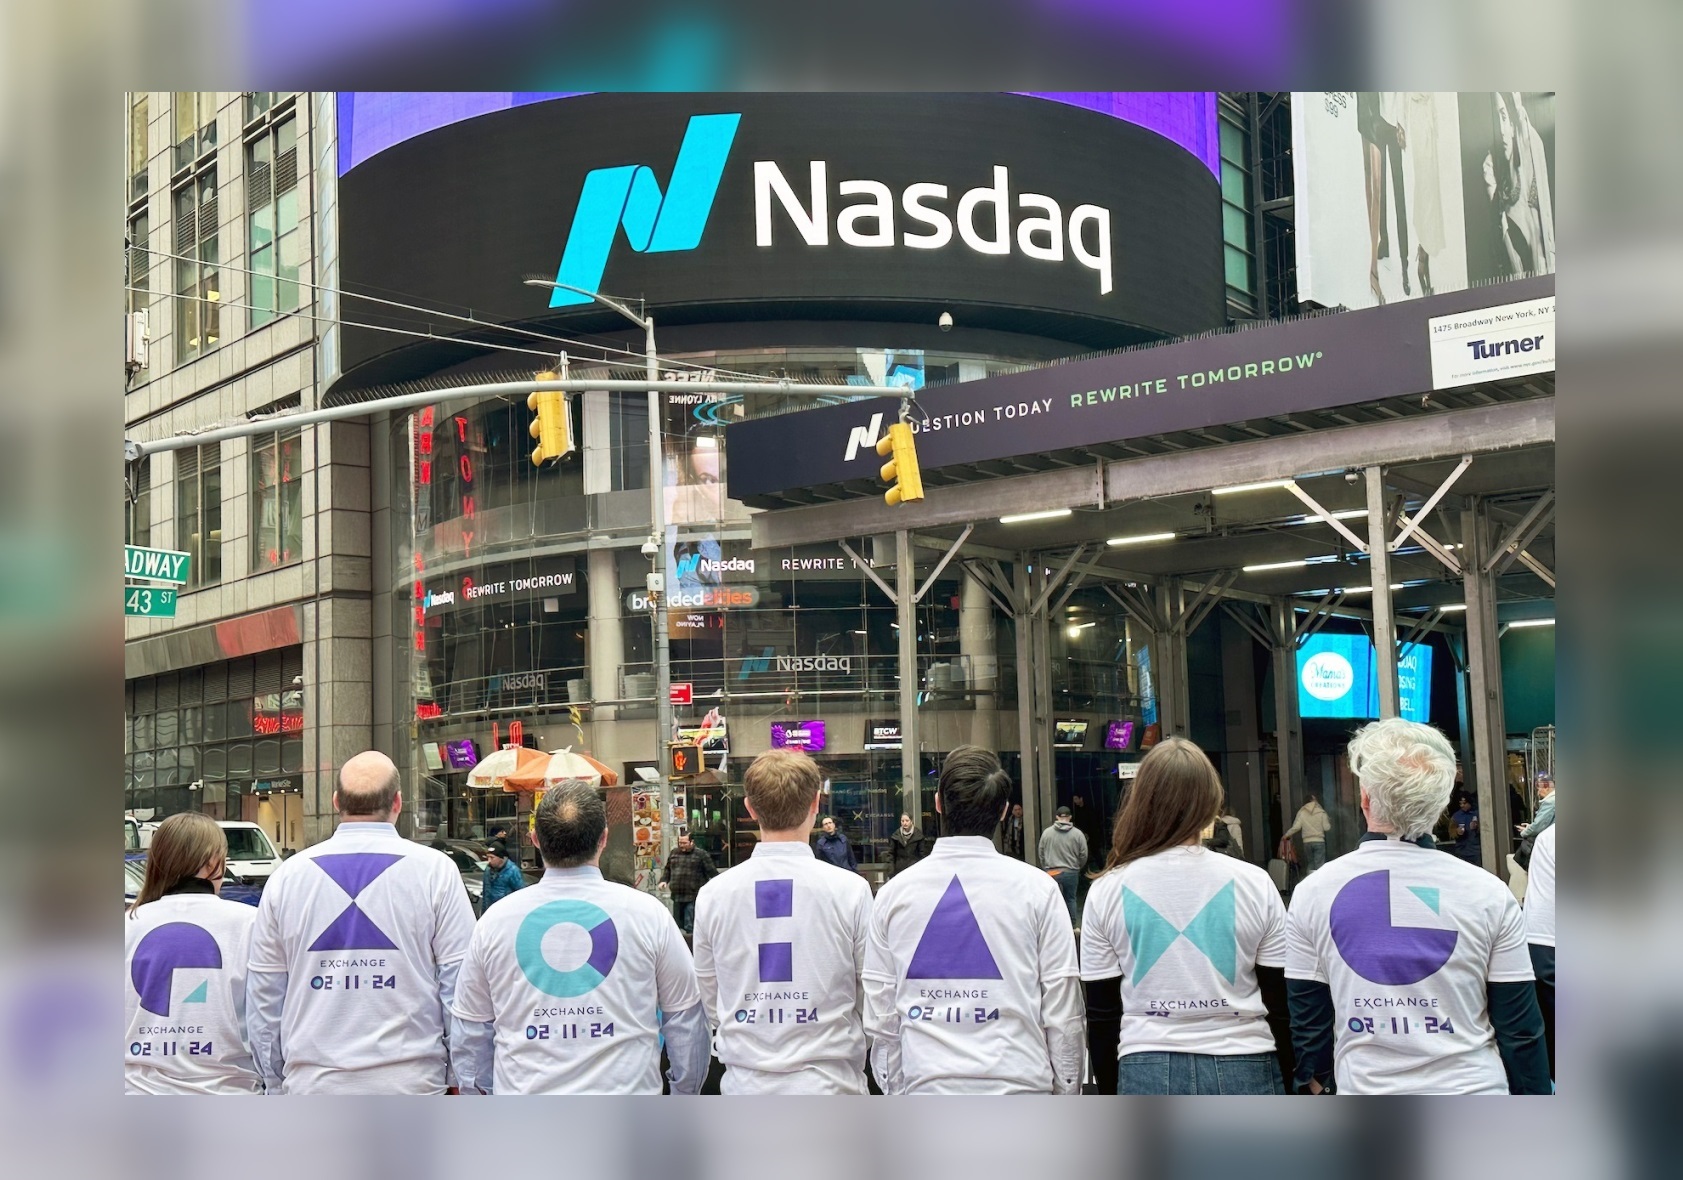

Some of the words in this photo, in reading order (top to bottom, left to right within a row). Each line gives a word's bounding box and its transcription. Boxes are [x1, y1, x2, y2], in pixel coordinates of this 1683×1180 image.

[753, 160, 1112, 296] Nasdaq
[1433, 324, 1452, 333] 1475
[1454, 316, 1494, 330] Broadway
[1495, 314, 1513, 322] New
[1516, 309, 1536, 319] York,
[1538, 307, 1549, 315] NY
[1467, 335, 1544, 360] Turner
[911, 409, 985, 434] UESTION
[993, 398, 1052, 420] TODAY
[1070, 378, 1167, 408] REWRITE
[701, 557, 754, 573] Nasdaq
[782, 558, 844, 570] REWRITE
[467, 582, 505, 599] REWRITE
[509, 573, 573, 591] TOMORROW
[126, 590, 151, 613] 43
[161, 591, 173, 604] ST
[431, 590, 455, 605] Nasdaq
[777, 653, 850, 675] Nasdaq
[503, 673, 544, 690] Nasdaq
[320, 959, 386, 969] EXCHANGE
[744, 991, 809, 1002] EXCHANGE
[920, 989, 988, 999] EXCHANGE
[1150, 998, 1229, 1011] EXCHANGE
[1354, 998, 1439, 1009] EXCHANGE
[533, 1006, 604, 1018] EXCHANGE
[139, 1026, 204, 1035] EXCHANGE
